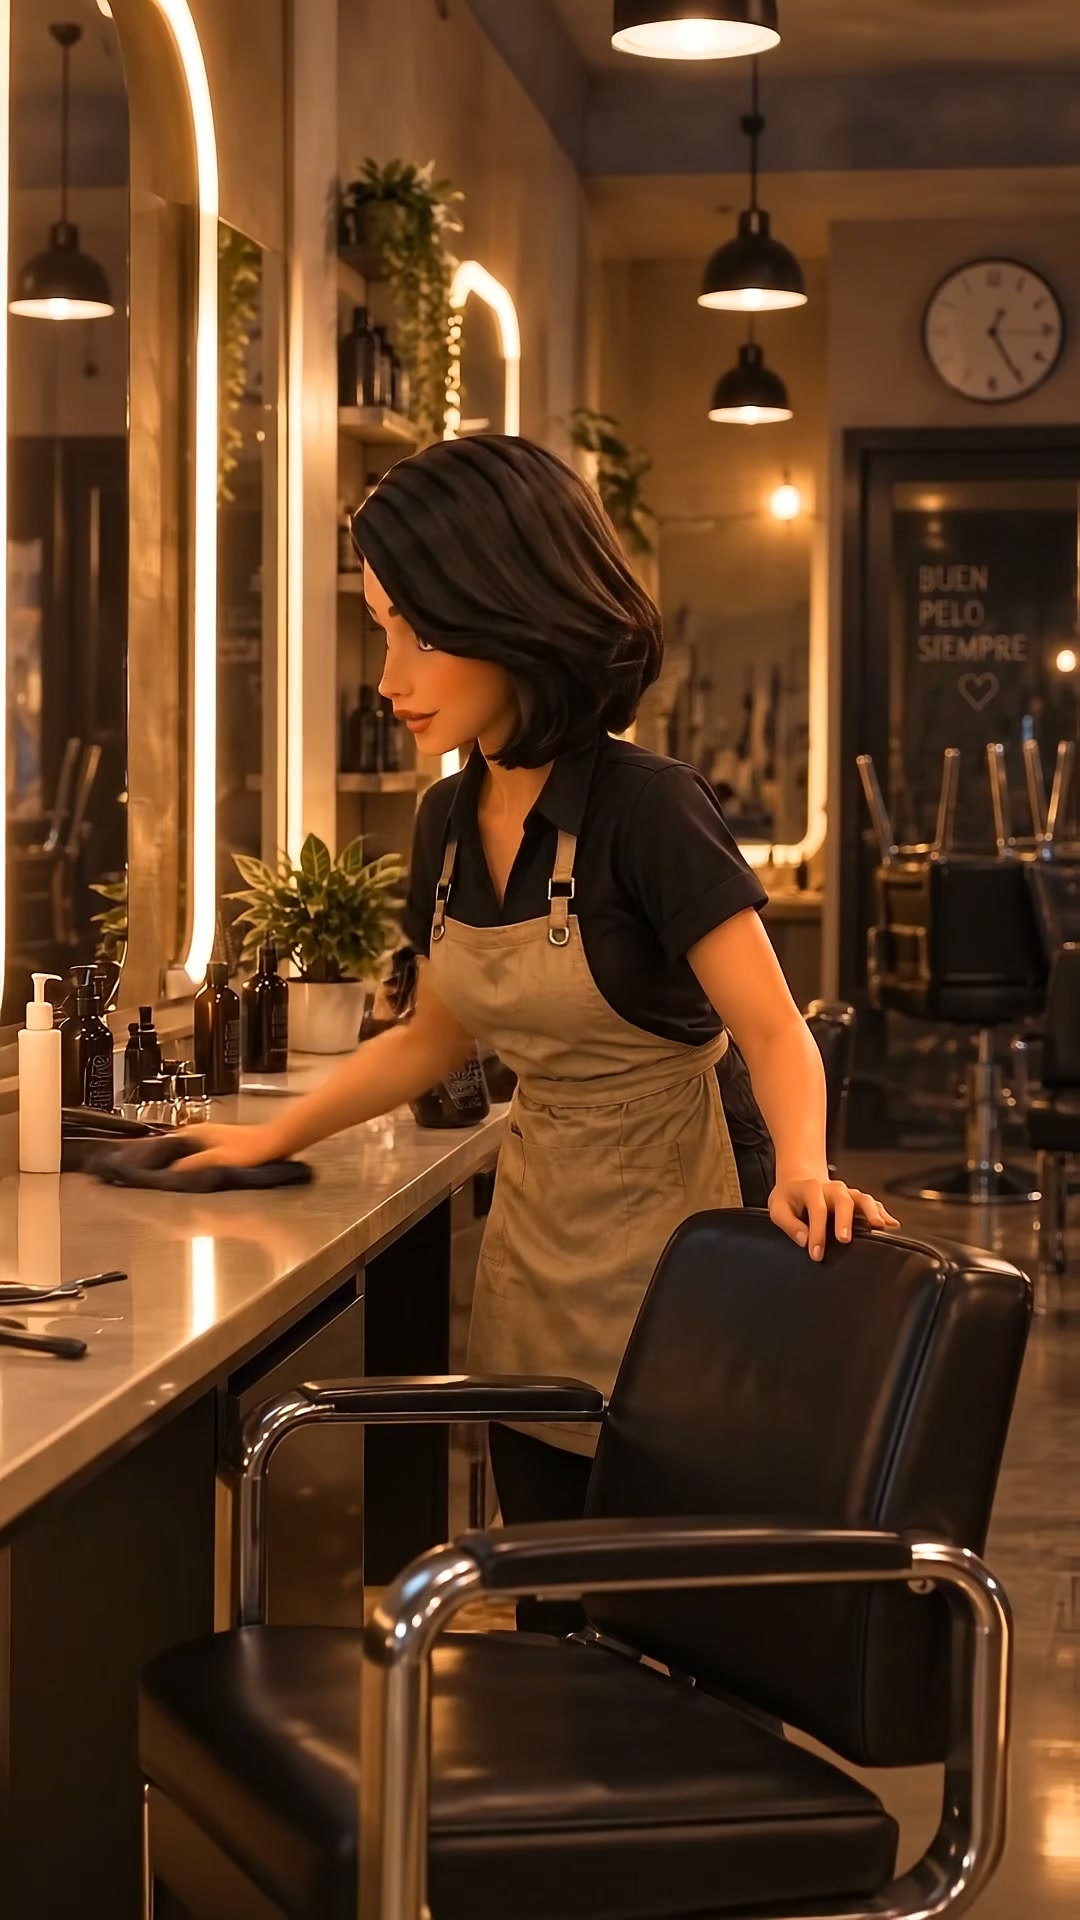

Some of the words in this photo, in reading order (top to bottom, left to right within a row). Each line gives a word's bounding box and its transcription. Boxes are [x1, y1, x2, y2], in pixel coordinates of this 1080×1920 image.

[919, 565, 988, 592] BUEN
[919, 599, 984, 627] PELO
[918, 634, 1027, 662] SIEMPRE
